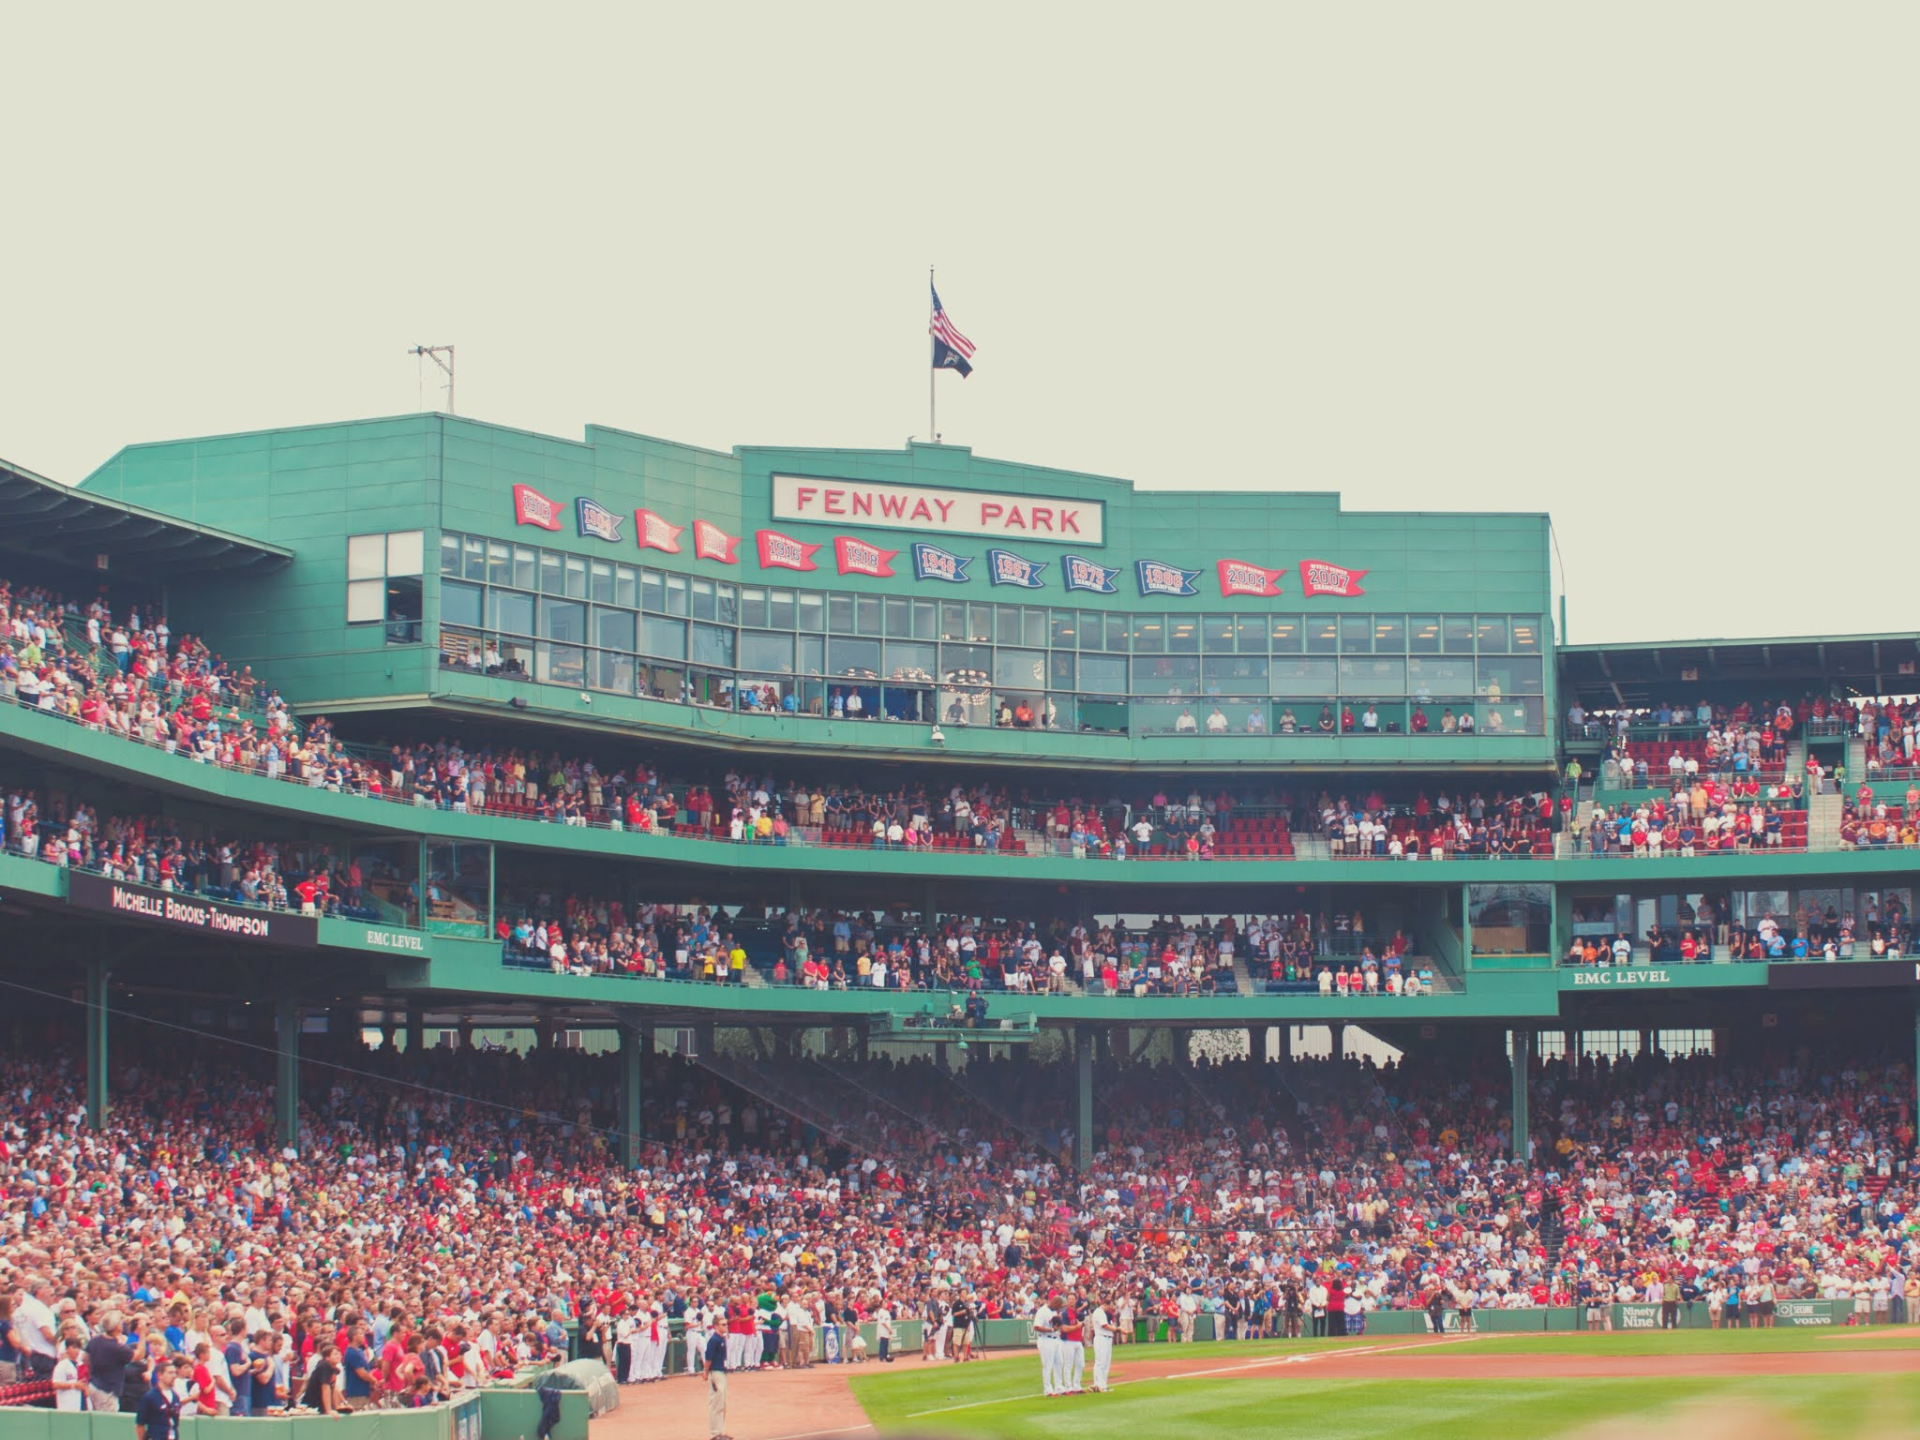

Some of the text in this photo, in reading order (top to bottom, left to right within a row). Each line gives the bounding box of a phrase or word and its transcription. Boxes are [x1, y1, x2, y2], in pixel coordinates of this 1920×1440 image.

[798, 487, 1080, 534] FENWAY PARK
[769, 540, 801, 561] 1916
[847, 547, 878, 567] 1918
[922, 553, 956, 574] 1946
[998, 559, 1031, 580] 1967
[1072, 563, 1105, 585] 1975
[1146, 568, 1183, 588] 1986
[1227, 569, 1266, 588] 2004
[1308, 569, 1349, 589] 2007
[112, 886, 163, 917] MICHELLE
[367, 930, 423, 951] EMC LEVEL
[1574, 970, 1670, 985] EMC LEVEL
[1622, 1306, 1656, 1317] Ninety
[1793, 1317, 1831, 1325] VOLVO
[1622, 1316, 1655, 1328] Nine
